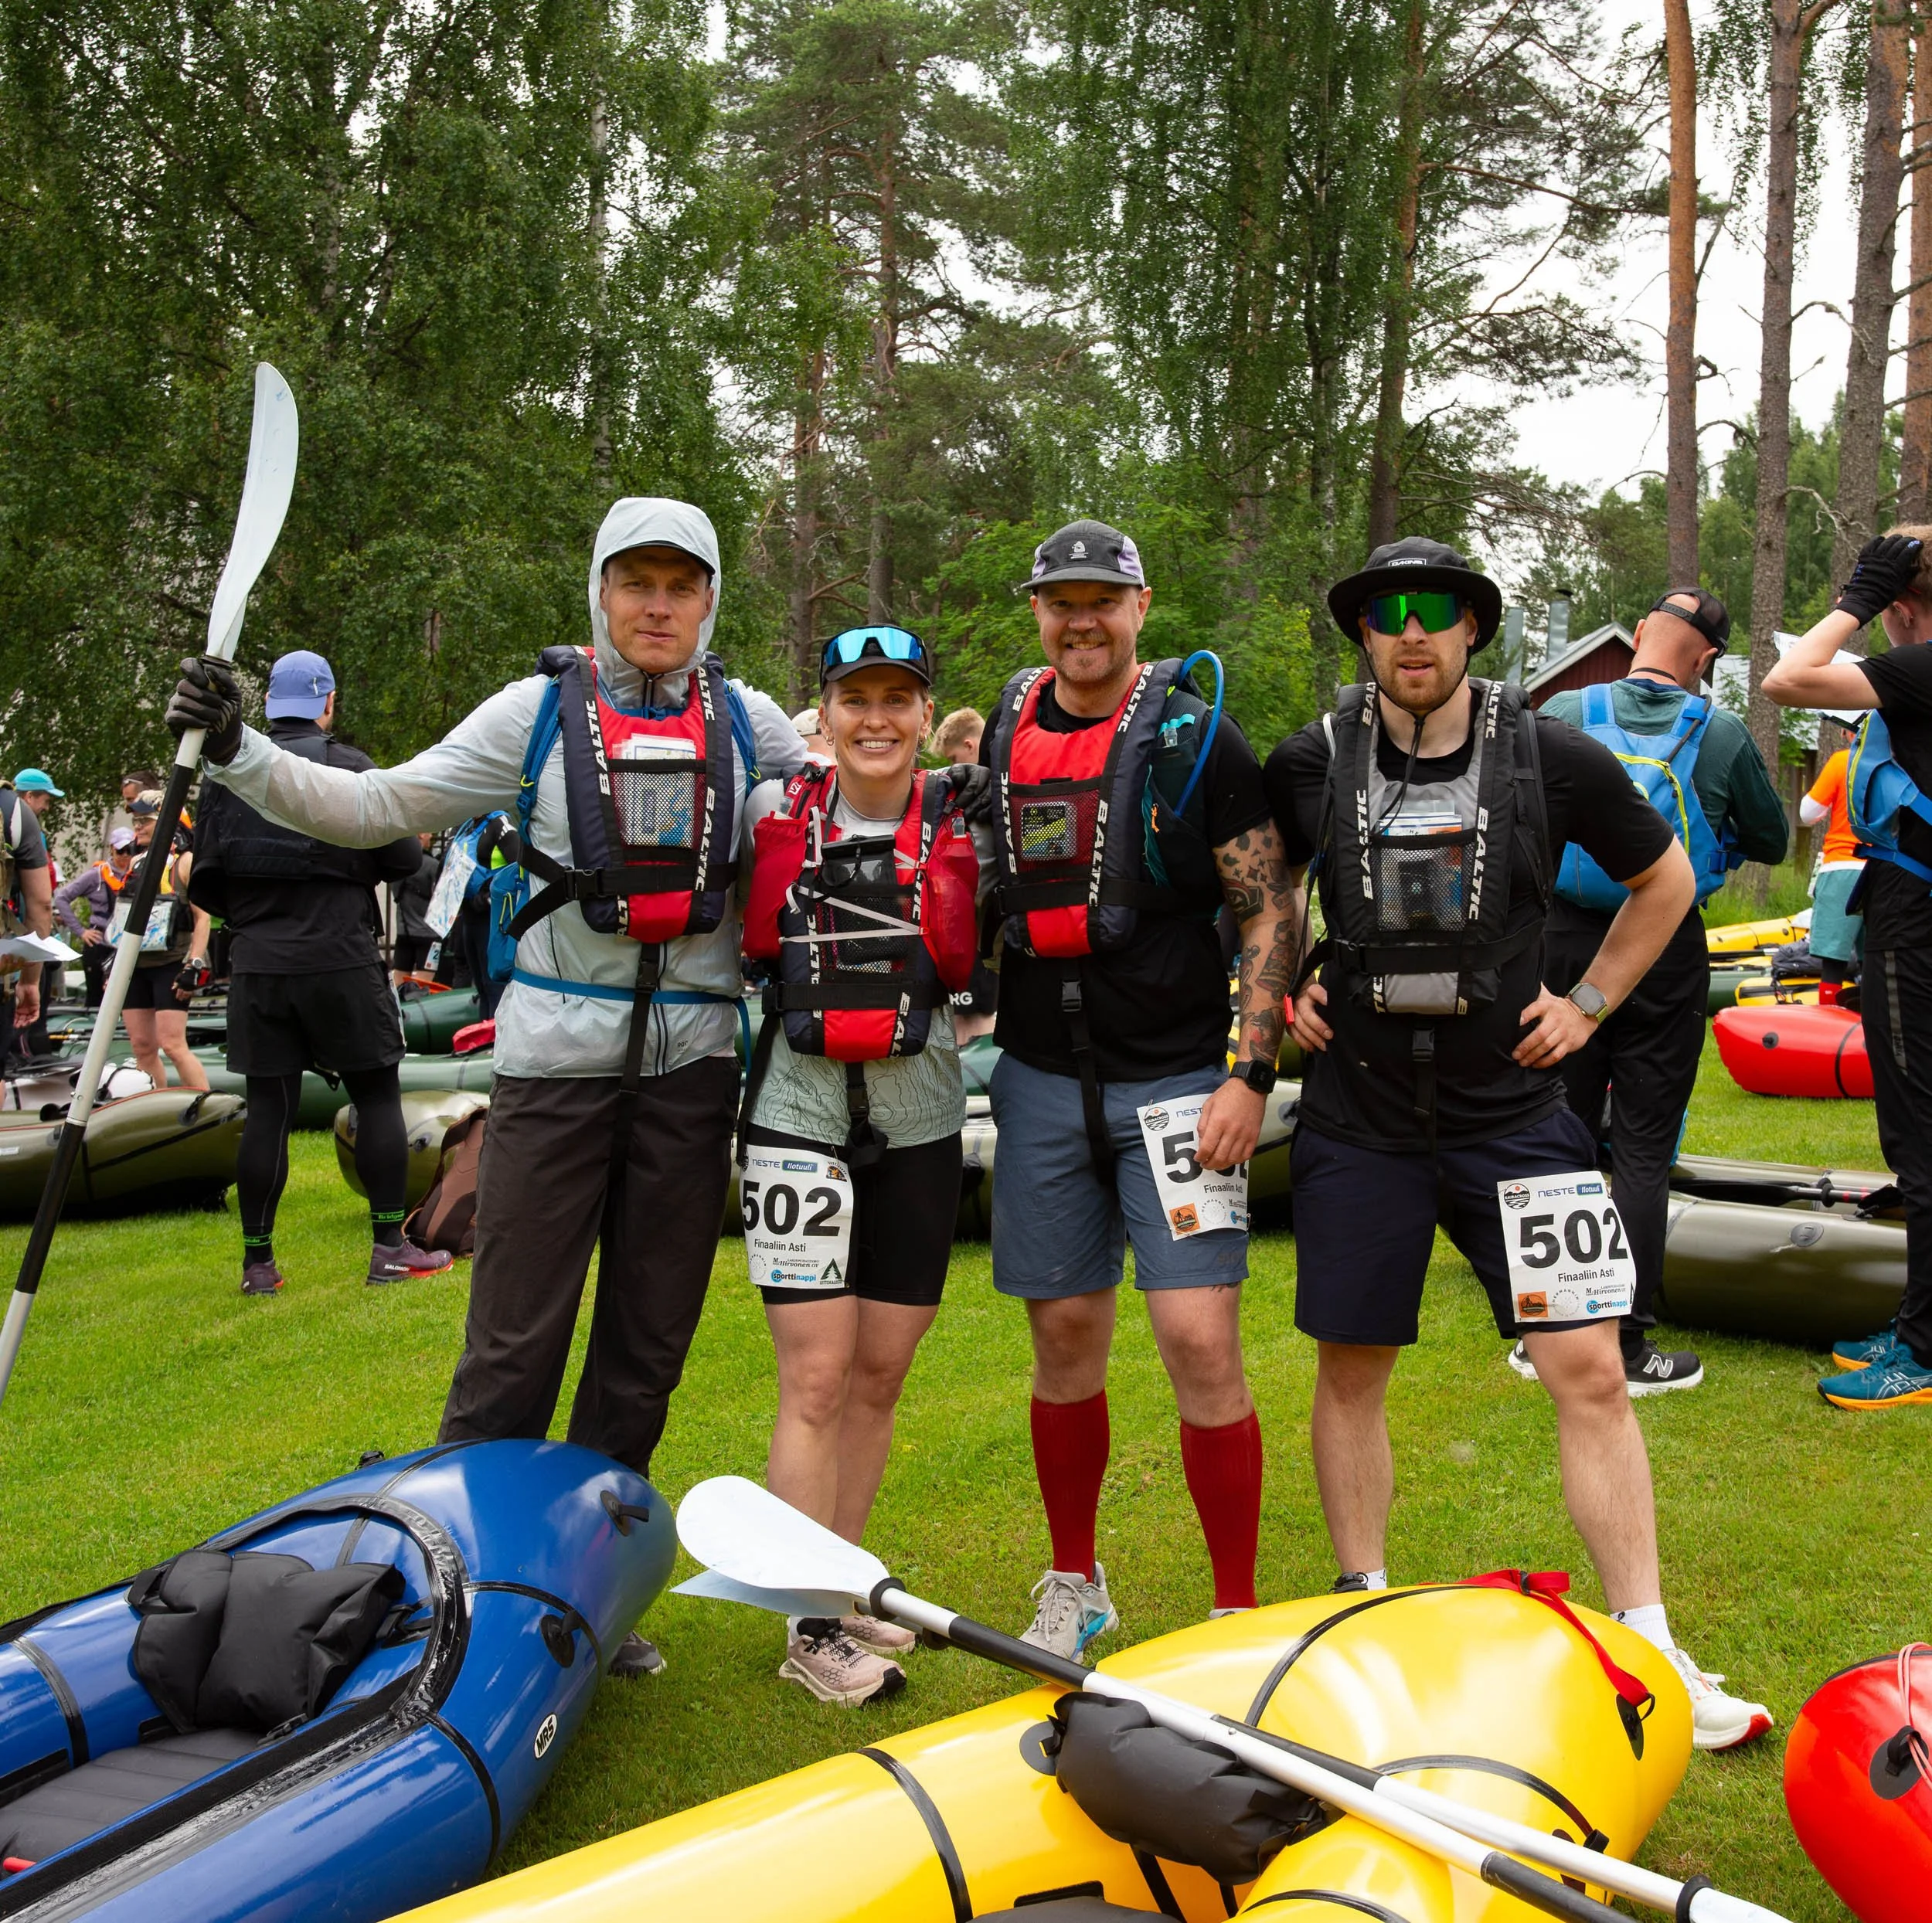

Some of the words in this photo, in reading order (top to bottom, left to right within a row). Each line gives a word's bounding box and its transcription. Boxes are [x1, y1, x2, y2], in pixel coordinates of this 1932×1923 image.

[697, 664, 716, 721] ALTIC
[1117, 664, 1155, 732] BALTIC
[1485, 681, 1505, 739] ALTIC
[585, 700, 612, 797] BALTIC
[695, 786, 716, 892] BALTIC
[1000, 772, 1018, 875] BALTIC
[1355, 789, 1374, 900] BALTIC
[1089, 799, 1109, 907] BALTIC
[1469, 807, 1488, 920] BALTIC
[1175, 1107, 1203, 1118] NEST
[752, 1159, 781, 1168] NESTE
[743, 1179, 842, 1237] 502
[1538, 1187, 1575, 1198] NESTE
[754, 1238, 787, 1251] Finaaliin
[788, 1242, 806, 1252] Asti
[780, 1259, 811, 1268] Hirvonen
[1520, 1207, 1628, 1269] 502
[773, 1272, 817, 1283] sporttinappi
[1558, 1269, 1598, 1283] Finaaliin
[1600, 1267, 1615, 1279] Asti
[1594, 1287, 1621, 1296] Hirvonen
[1589, 1298, 1628, 1311] sporttinappi
[536, 1716, 554, 1757] MRS
